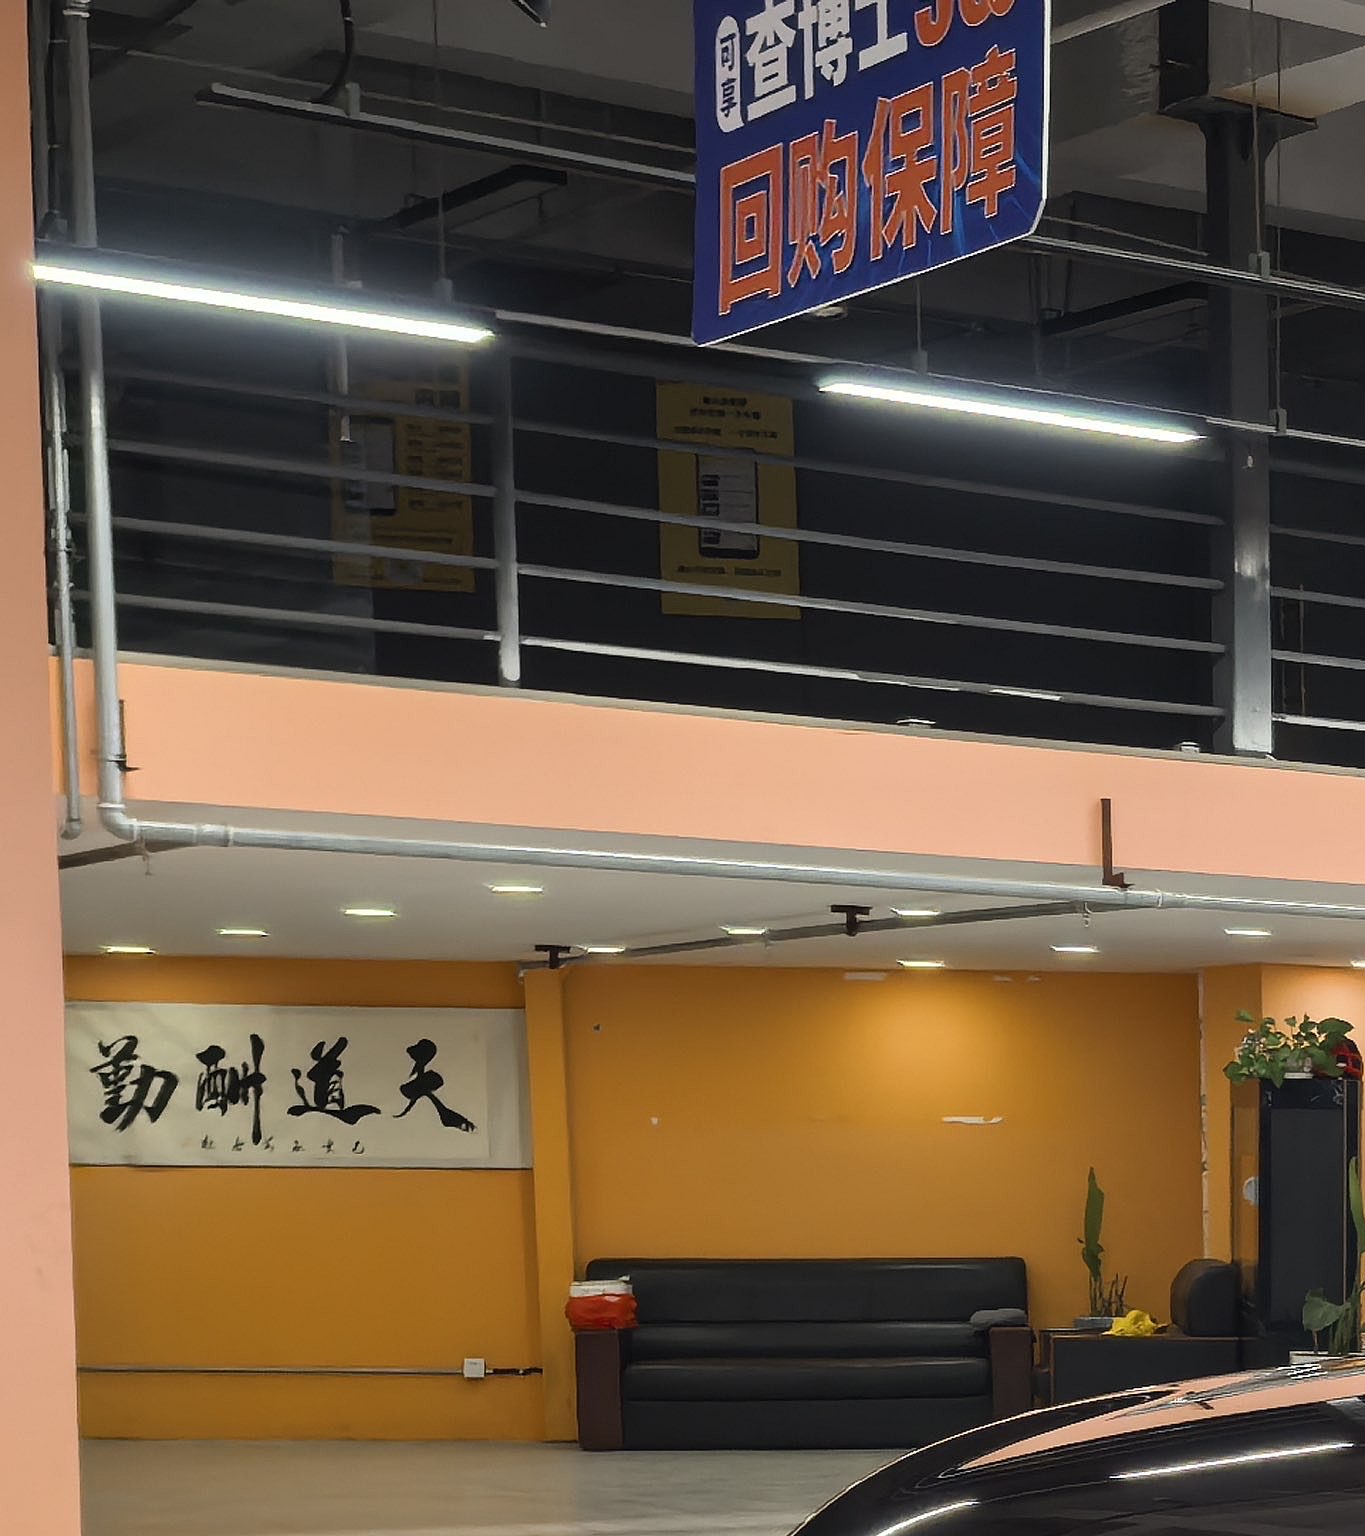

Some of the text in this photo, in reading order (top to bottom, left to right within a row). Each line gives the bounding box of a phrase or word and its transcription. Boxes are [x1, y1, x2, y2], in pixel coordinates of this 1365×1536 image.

[720, 34, 739, 118] 可享
[719, 45, 1017, 316] 回购保障
